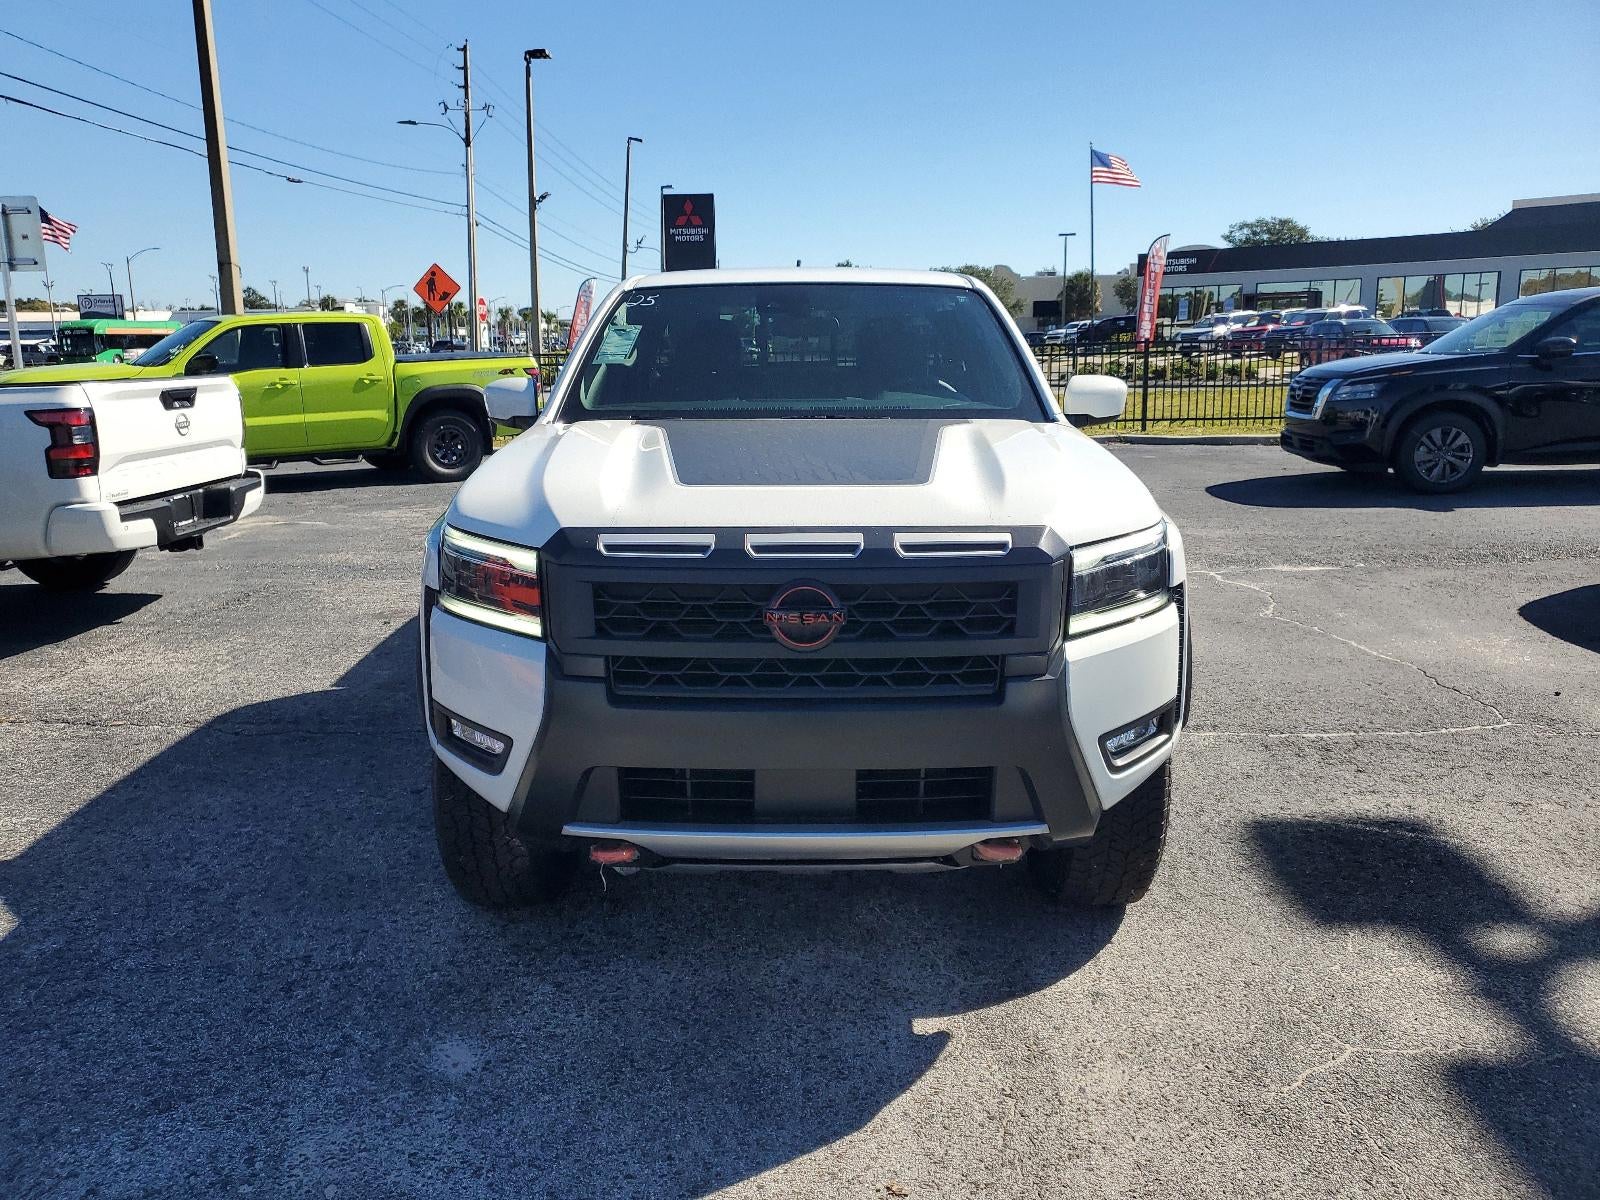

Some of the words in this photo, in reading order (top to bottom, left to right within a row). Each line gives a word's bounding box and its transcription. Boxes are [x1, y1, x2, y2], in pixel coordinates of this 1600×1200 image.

[669, 227, 709, 235] MITSUBISHI
[1166, 257, 1197, 266] ITSUBISHI
[626, 294, 660, 307] 25
[766, 612, 844, 624] NISSAN
